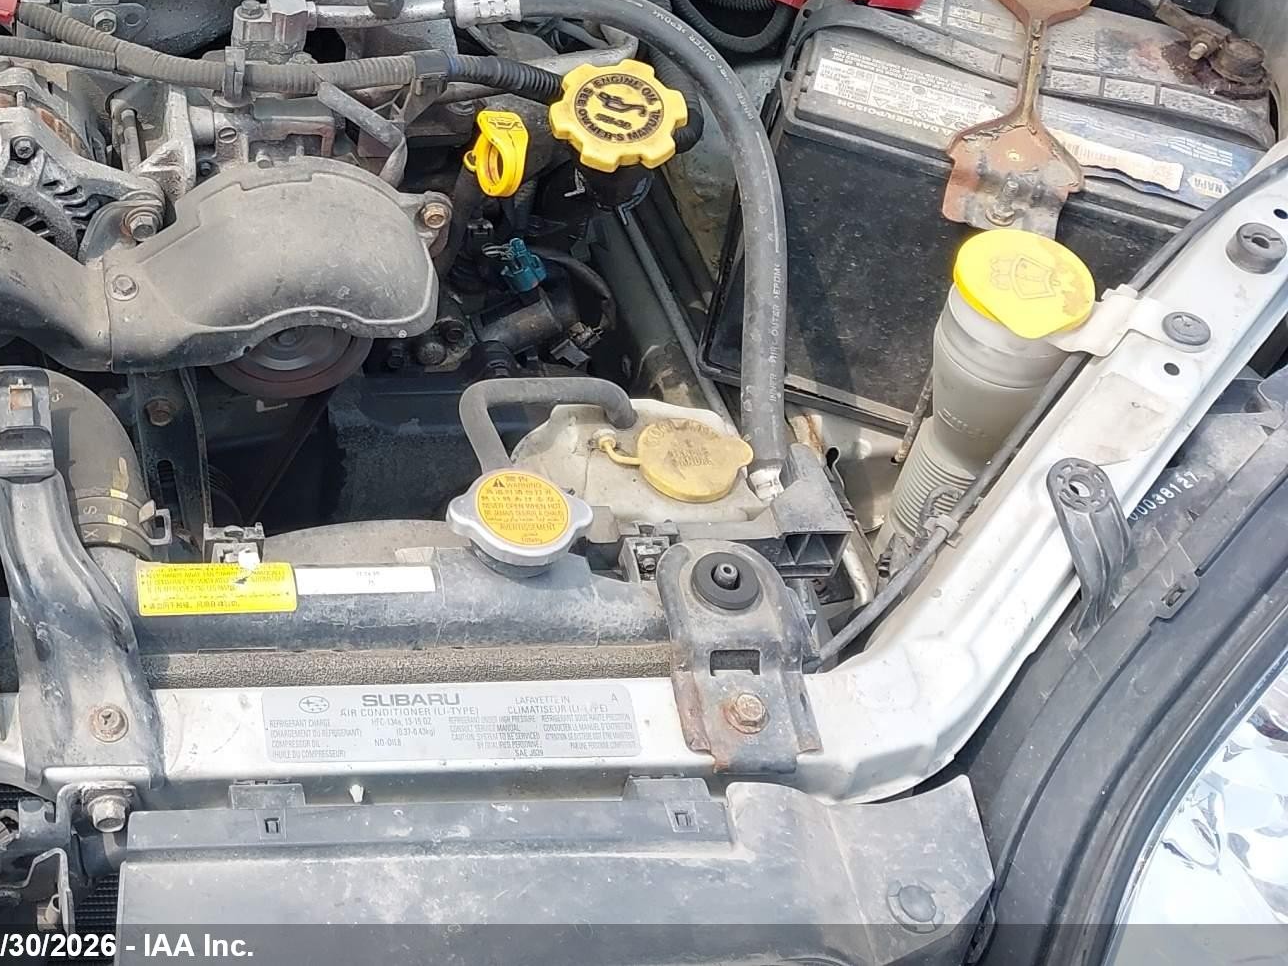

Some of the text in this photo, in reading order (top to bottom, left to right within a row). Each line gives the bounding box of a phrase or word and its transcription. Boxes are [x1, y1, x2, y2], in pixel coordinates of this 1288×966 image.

[593, 74, 659, 106] ENGINE OIL
[576, 86, 594, 108] SEE
[626, 109, 661, 141] MANUAL
[1193, 177, 1224, 195] NAPA
[361, 693, 461, 707] SUBARU
[340, 708, 358, 717] AIR
[361, 707, 431, 718] CONDITIONER
[507, 705, 568, 714] CLIMATISEUR
